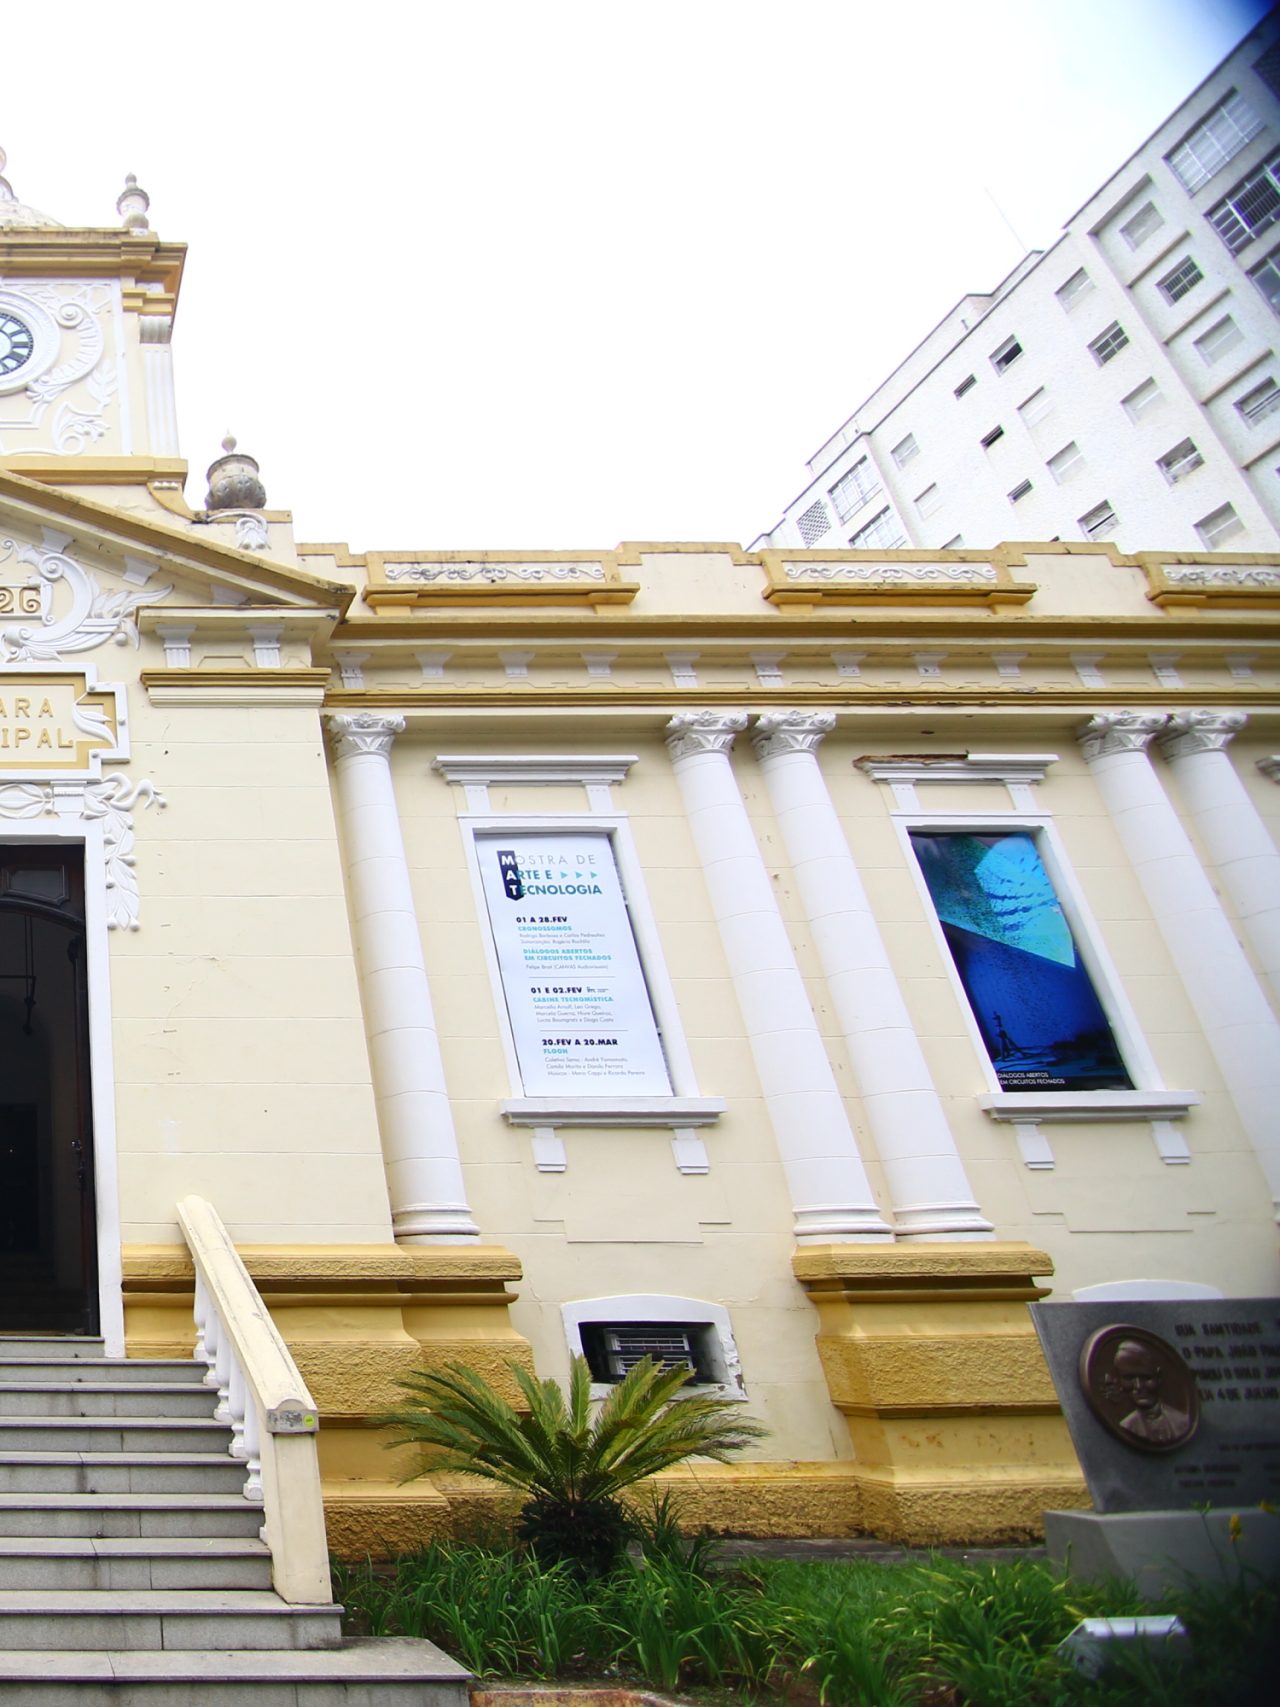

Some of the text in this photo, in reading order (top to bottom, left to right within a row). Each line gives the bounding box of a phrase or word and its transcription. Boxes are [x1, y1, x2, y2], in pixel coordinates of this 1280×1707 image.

[501, 855, 596, 866] MOSTRA DE
[506, 870, 553, 880] ARTE E
[509, 884, 602, 896] TECNOLOGIA
